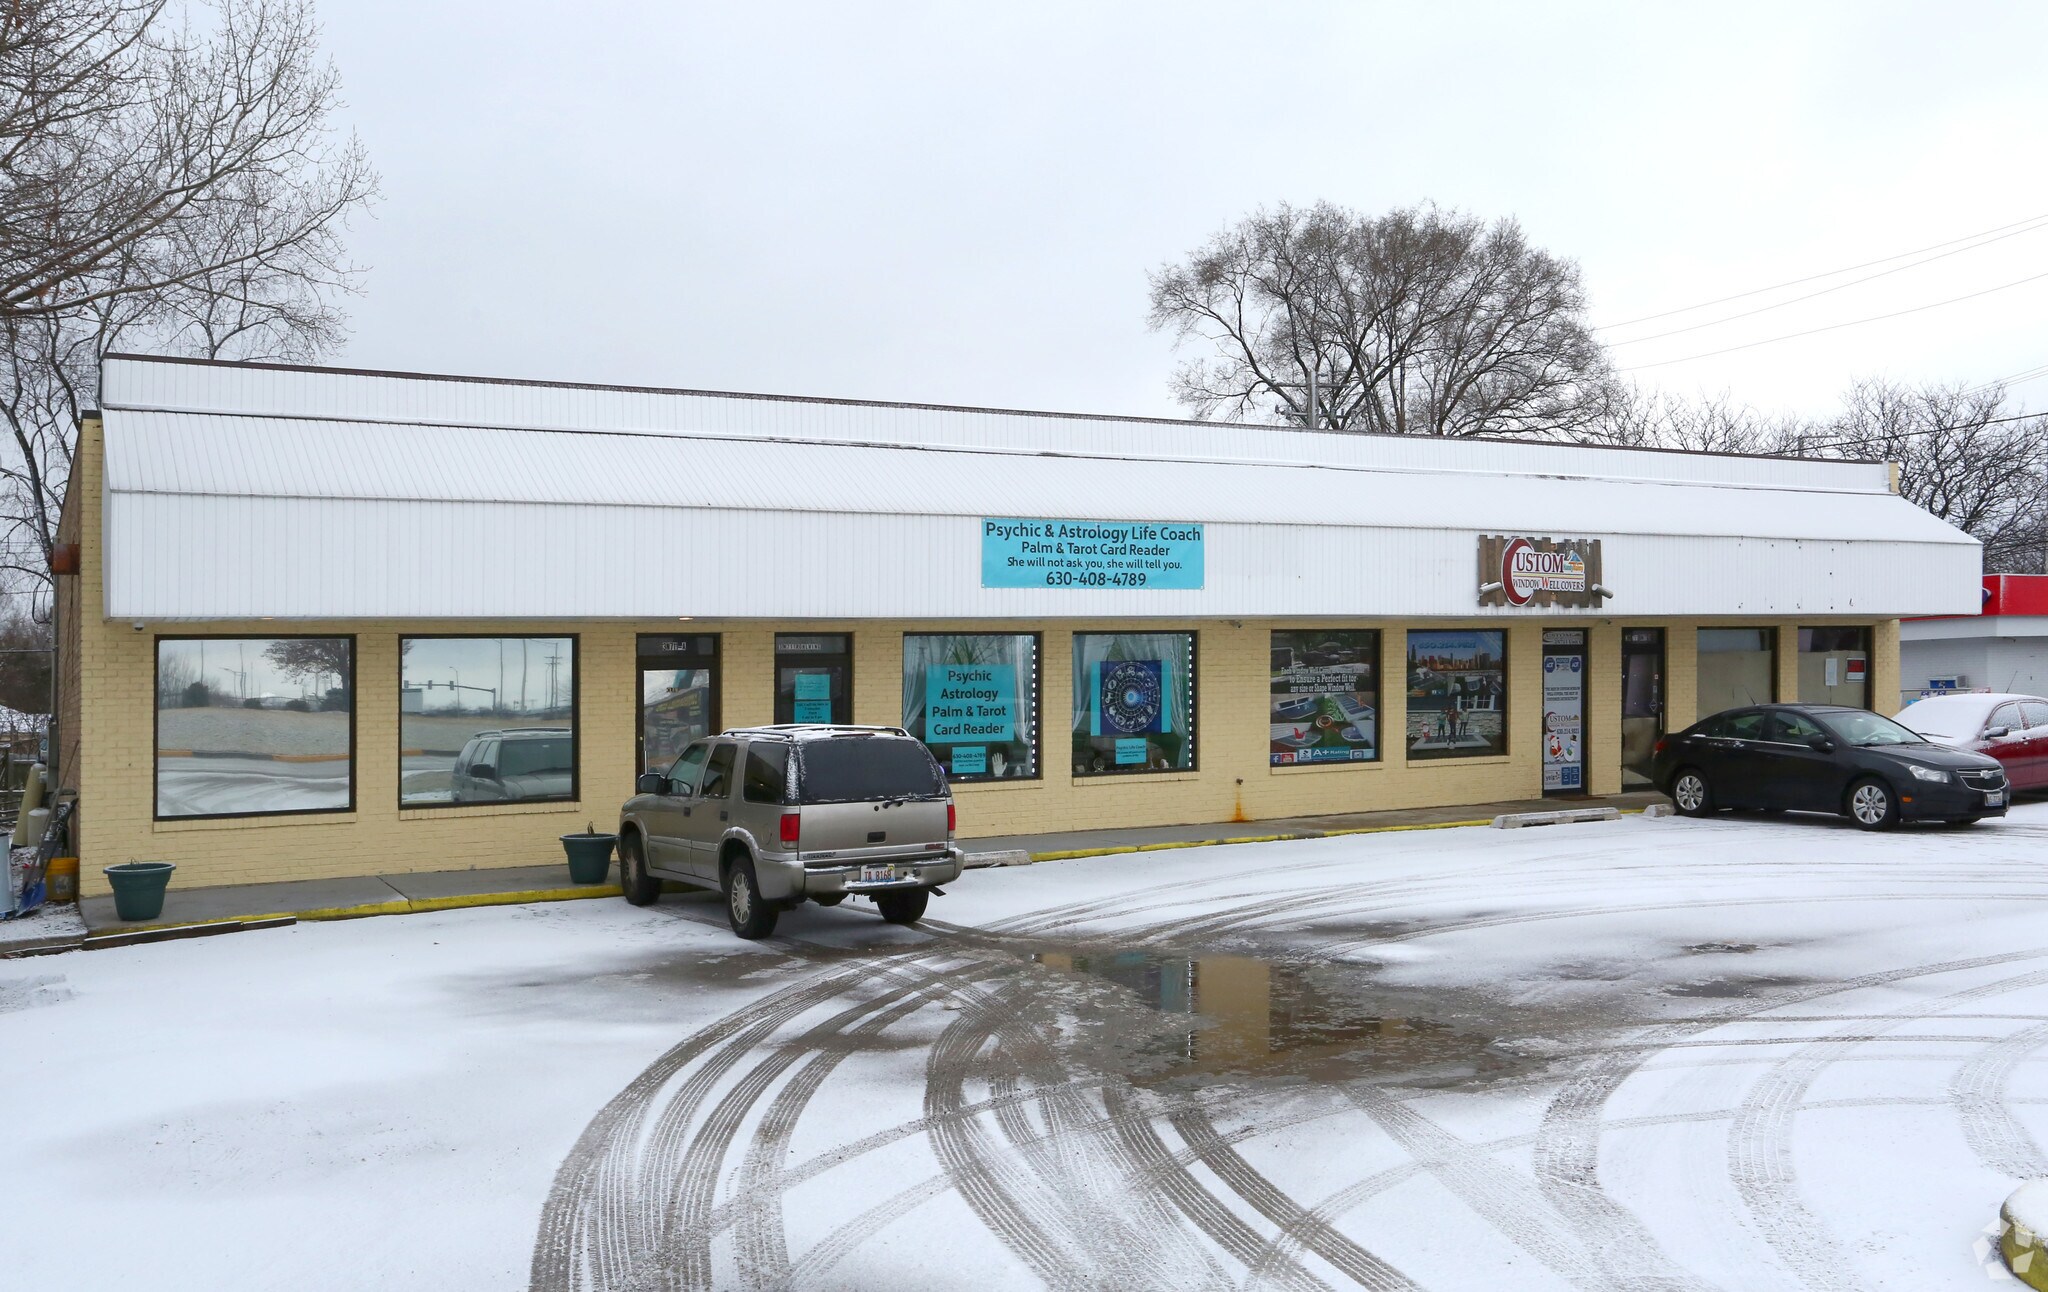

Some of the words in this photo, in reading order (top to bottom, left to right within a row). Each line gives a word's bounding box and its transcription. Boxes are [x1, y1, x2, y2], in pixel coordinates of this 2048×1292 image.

[985, 521, 1041, 541] Psychic
[1044, 523, 1055, 538] &
[1058, 523, 1128, 544] Astrology
[1131, 526, 1157, 540] Life
[1160, 526, 1201, 541] Coach
[1021, 541, 1053, 554] Palm
[1055, 542, 1064, 554] &
[1067, 542, 1098, 555] Tarot
[1100, 543, 1127, 555] Card
[1129, 544, 1170, 556] Reader
[1007, 556, 1025, 567] She
[1027, 556, 1045, 567] will
[1047, 558, 1064, 568] not
[1066, 558, 1083, 568] ask
[1084, 560, 1105, 571] you,
[1106, 558, 1124, 569] she
[1125, 559, 1144, 569] will
[1145, 559, 1161, 569] tell
[1163, 561, 1183, 572] you.
[1502, 537, 1564, 605] CUSTOM
[1046, 571, 1147, 587] 630-408-4789
[1512, 578, 1540, 589] WINDOW
[1541, 577, 1560, 590] WELL
[1560, 580, 1584, 591] COVERS
[948, 669, 992, 685] Psychic
[1296, 674, 1316, 683] Ensure
[1321, 674, 1341, 683] Perfect
[940, 688, 999, 702] Astrology
[1290, 686, 1299, 694] any
[1299, 684, 1309, 693] size
[1314, 683, 1327, 694] Shape
[1327, 683, 1345, 692] Window
[932, 706, 963, 718] Palm
[965, 706, 974, 717] &
[976, 705, 1007, 717] Tarot
[933, 723, 961, 736] Card
[963, 723, 1005, 735] Reader
[1313, 749, 1329, 757] A+
[864, 870, 872, 881] TA
